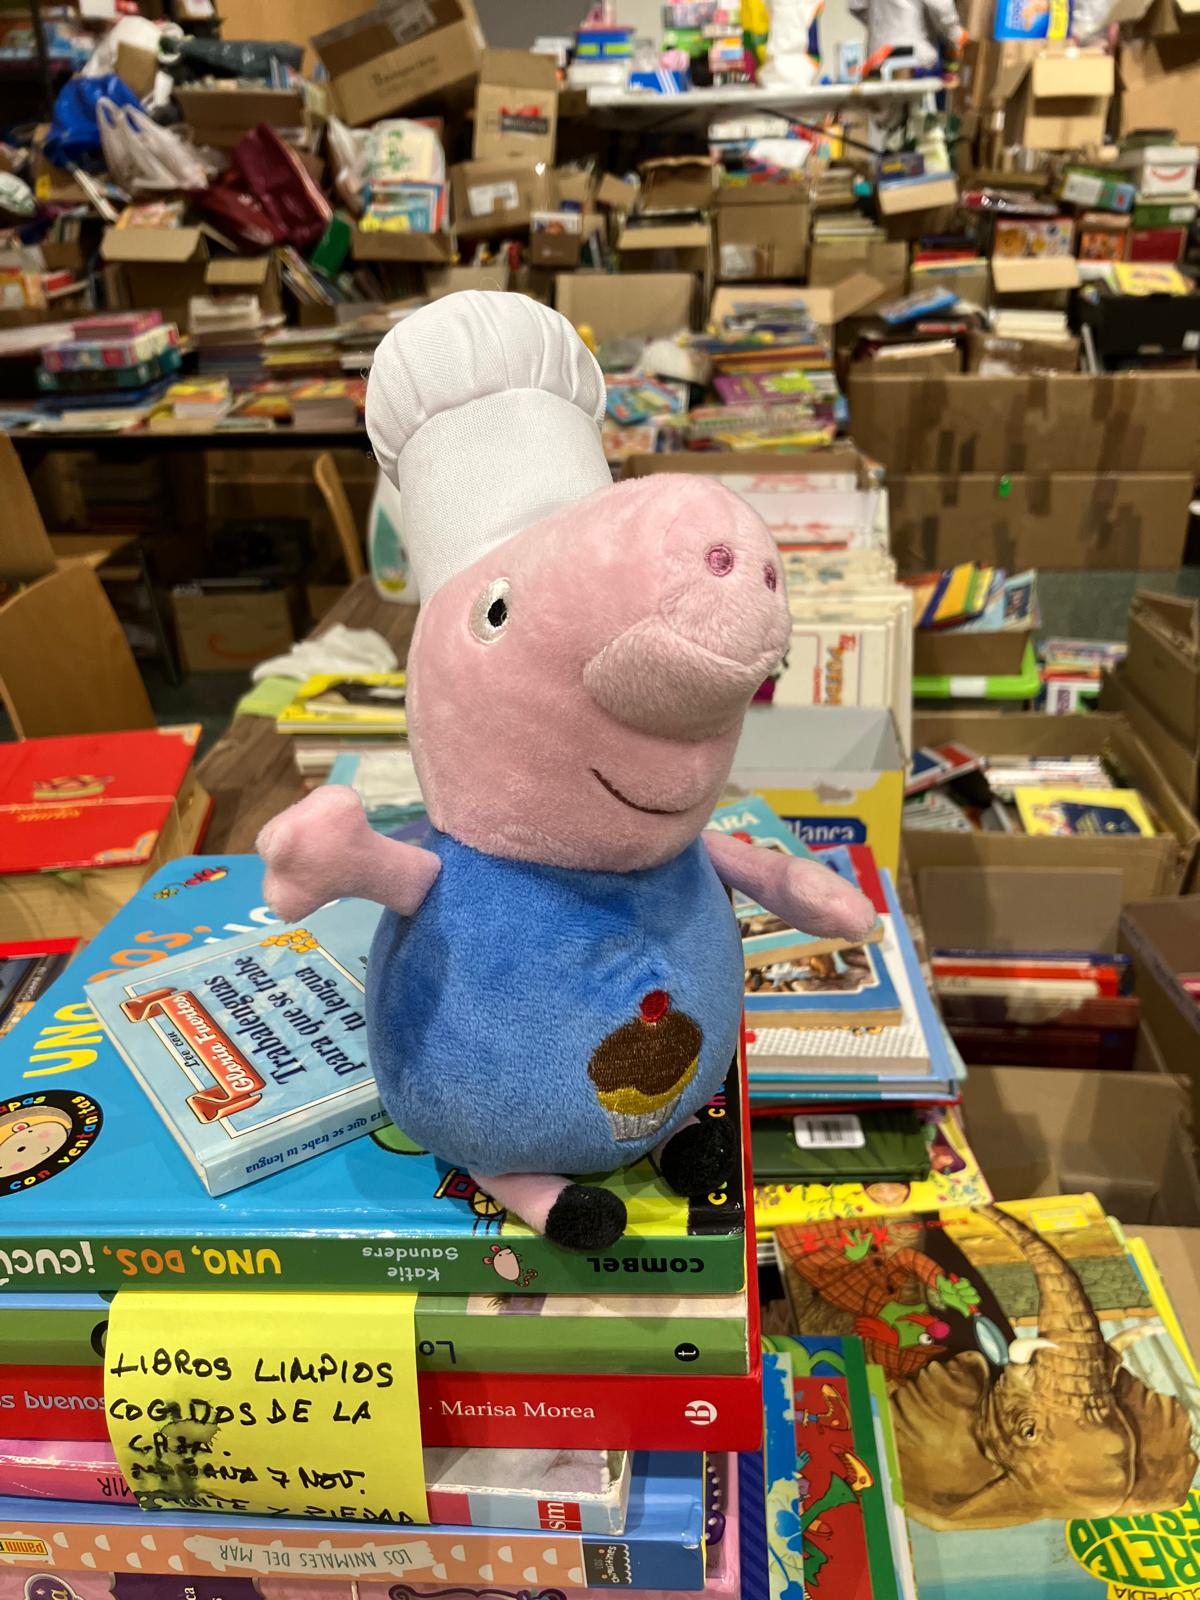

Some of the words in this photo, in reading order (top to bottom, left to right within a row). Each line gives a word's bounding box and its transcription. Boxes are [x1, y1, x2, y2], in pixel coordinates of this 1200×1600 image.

[233, 956, 279, 993] trabe
[267, 991, 293, 1008] se
[294, 966, 352, 1016] lengua
[172, 994, 217, 1045] Fuertes
[203, 975, 307, 1085] Trabalenguas
[282, 1006, 325, 1036] que
[340, 1011, 367, 1033] tu
[182, 1049, 200, 1069] Lee
[210, 1041, 256, 1093] Gloria
[310, 1036, 367, 1077] para
[287, 1146, 299, 1157] tu
[301, 1134, 330, 1151] trabe
[245, 1153, 285, 1174] lengua
[10, 1170, 51, 1190] con
[102, 1245, 186, 1276] DOS,
[191, 1245, 282, 1275] UNO,
[362, 1246, 459, 1261] Saunders
[387, 1265, 440, 1282] Katie
[110, 1348, 233, 1381] LIBROS
[254, 1353, 394, 1388] LIMPIOS
[266, 1398, 313, 1425] DE
[332, 1400, 372, 1425] LA
[441, 1400, 517, 1417] Marisa
[522, 1401, 596, 1419] Morea
[267, 1466, 290, 1489] 7
[298, 1466, 366, 1495] NOV.
[546, 1502, 567, 1530] sm
[219, 1544, 253, 1562] MAR
[262, 1550, 290, 1567] DEL
[299, 1550, 377, 1569] ANIMALES
[383, 1548, 413, 1565] LOS
